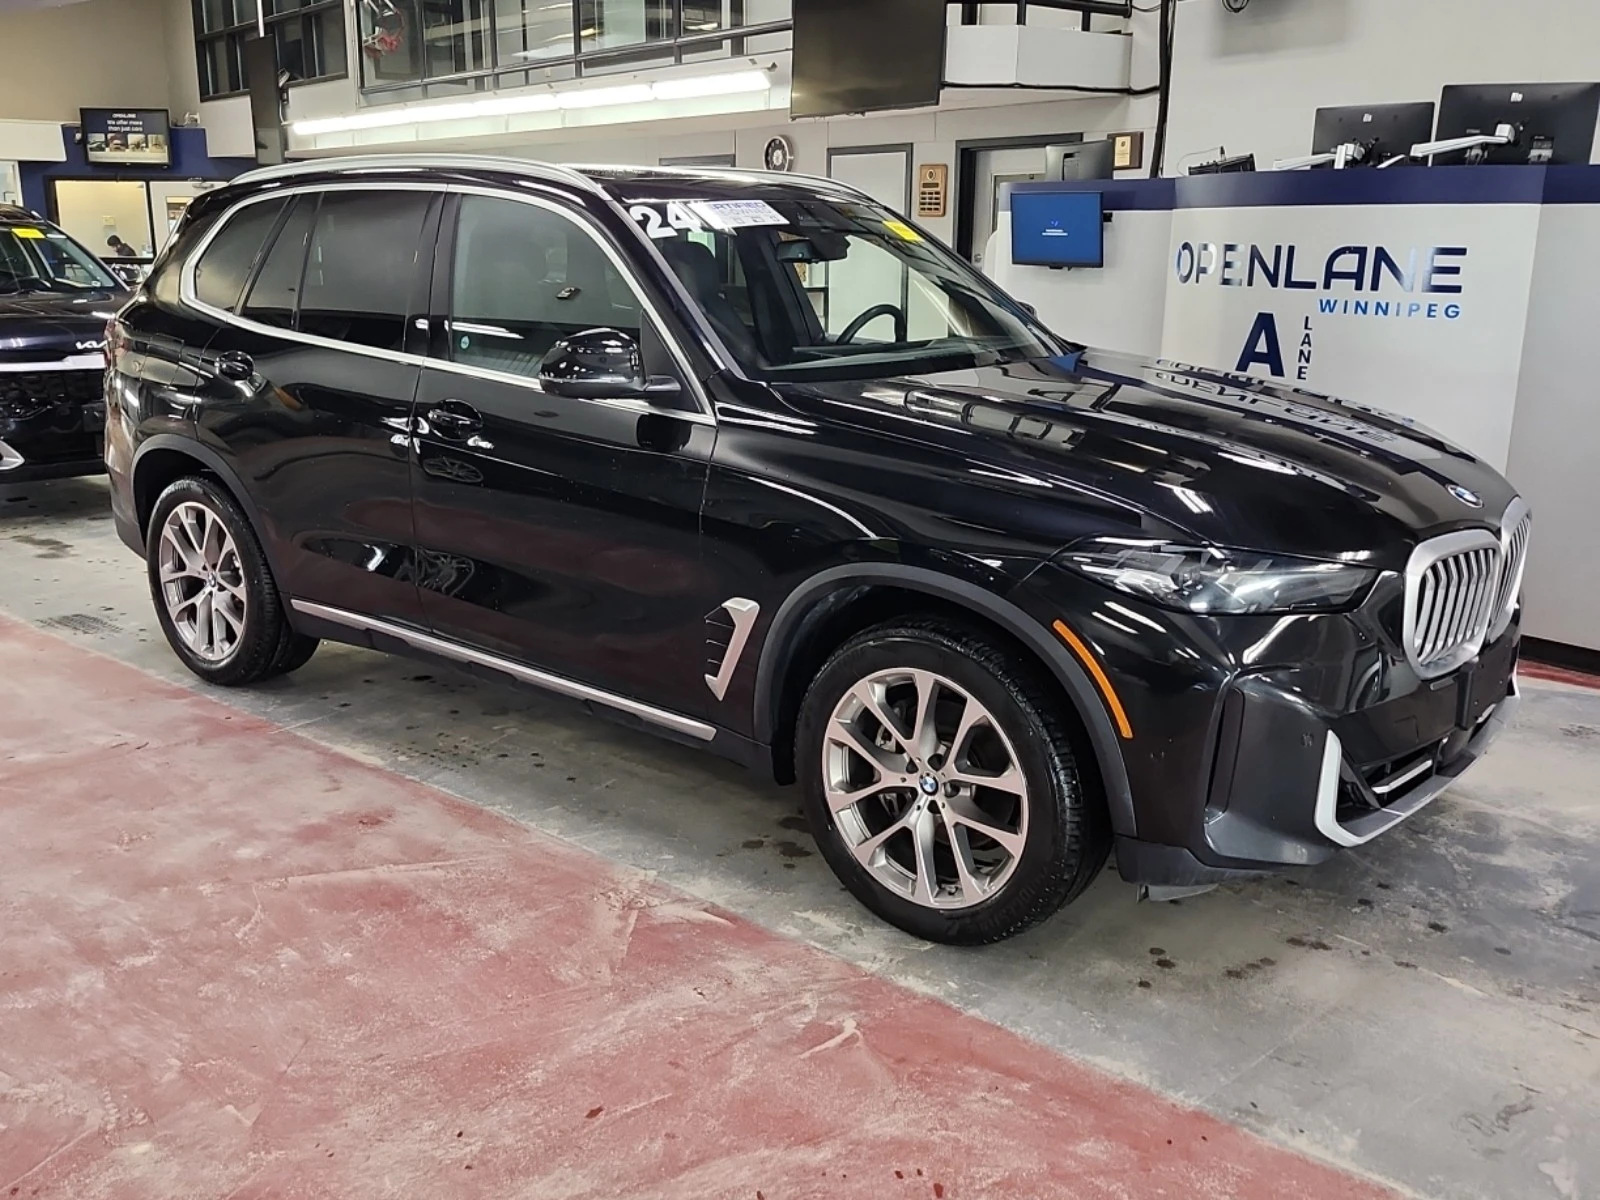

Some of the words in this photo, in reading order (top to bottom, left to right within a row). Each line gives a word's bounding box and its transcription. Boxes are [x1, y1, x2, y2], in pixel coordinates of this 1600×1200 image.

[1175, 241, 1468, 293] OPENLANE
[1318, 298, 1461, 319] WINNIPEG
[1234, 311, 1285, 378] A
[1296, 315, 1313, 380] LANE
